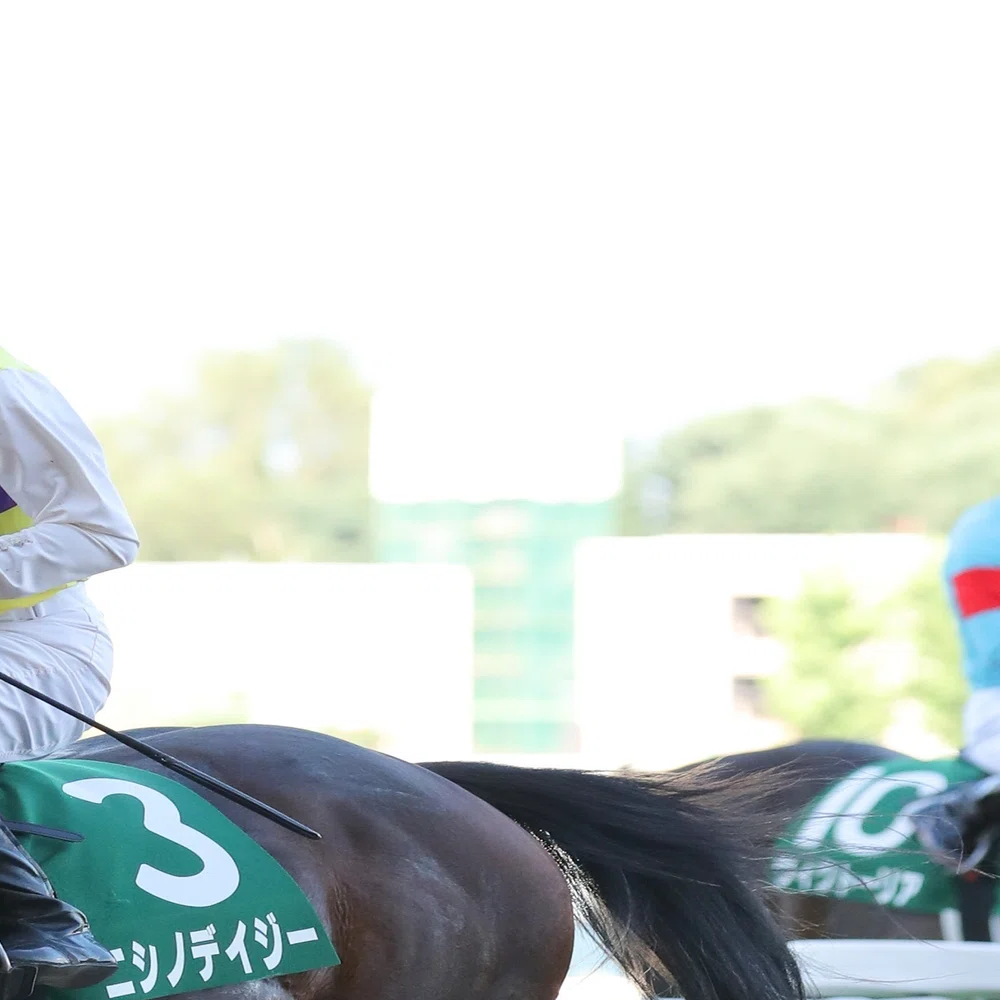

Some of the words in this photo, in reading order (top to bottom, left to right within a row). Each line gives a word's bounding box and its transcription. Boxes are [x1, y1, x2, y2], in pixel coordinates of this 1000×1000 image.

[62, 778, 239, 907] 3
[794, 766, 947, 856] 10
[106, 912, 318, 998] ニシノデイジー
